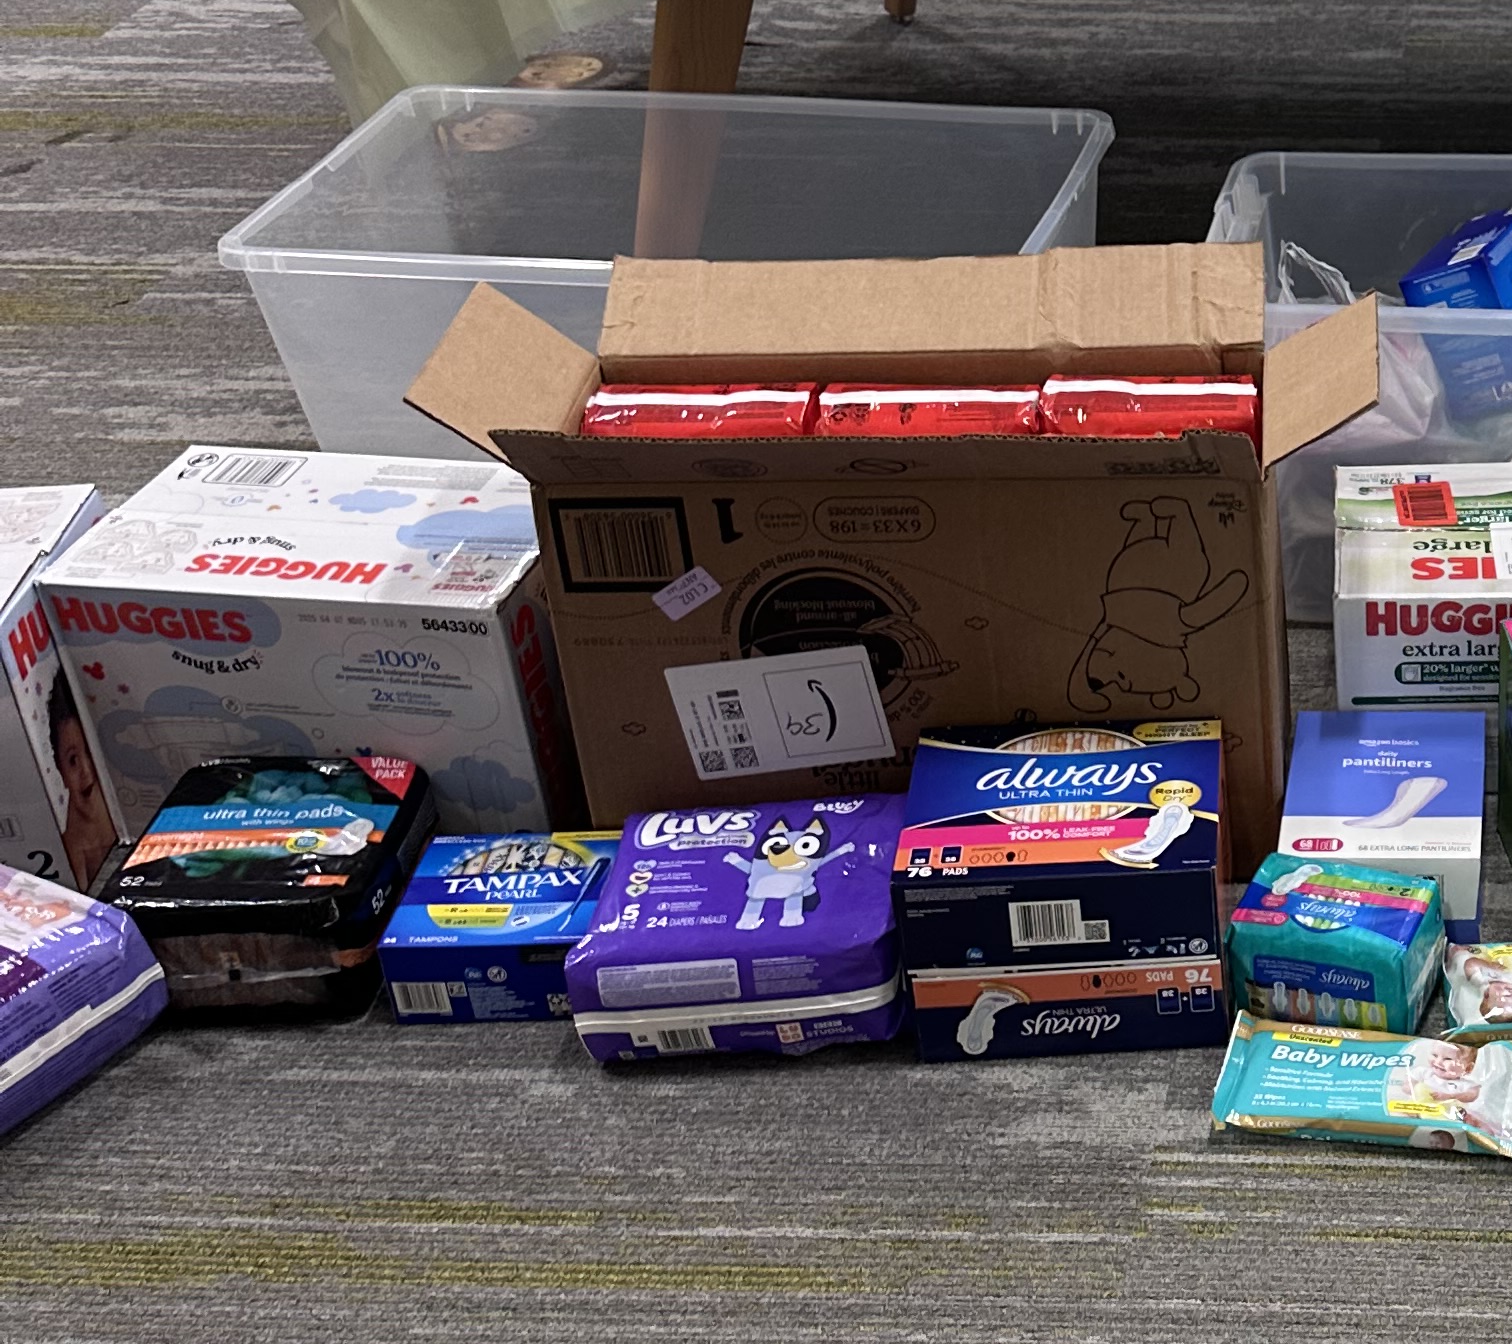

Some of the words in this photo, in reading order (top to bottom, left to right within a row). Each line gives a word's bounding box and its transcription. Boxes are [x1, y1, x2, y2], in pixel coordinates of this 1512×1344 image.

[712, 499, 743, 544] 1
[184, 554, 387, 585] HUGGIES
[51, 595, 252, 643] HUGGIES
[1402, 641, 1460, 657] extra
[172, 650, 214, 673] snug
[217, 660, 230, 673] &
[231, 654, 261, 672] dry
[375, 649, 441, 671] 100%
[1423, 664, 1448, 673] 20%
[371, 757, 408, 769] VALUE
[1342, 758, 1432, 768] pantiliners
[375, 769, 405, 780] PACK
[976, 758, 1162, 796] always
[1000, 789, 1050, 799] ULTRA
[1056, 788, 1093, 797] THIN
[1156, 786, 1194, 796] Rapid
[204, 807, 247, 820] ultra
[254, 808, 289, 819] thin
[295, 804, 344, 820] pads
[1008, 829, 1060, 841] 100%
[28, 850, 59, 879] 2
[907, 867, 932, 877] 76
[942, 867, 968, 876] PADS
[120, 877, 144, 887] 52
[444, 870, 582, 894] TAMPAX
[646, 917, 668, 928] 24
[1145, 971, 1174, 982] PADS
[1185, 968, 1213, 983] 76
[1319, 968, 1370, 990] always
[1021, 1010, 1120, 1039] always
[1272, 1045, 1334, 1068] Baby
[1340, 1052, 1415, 1069] Wipes
